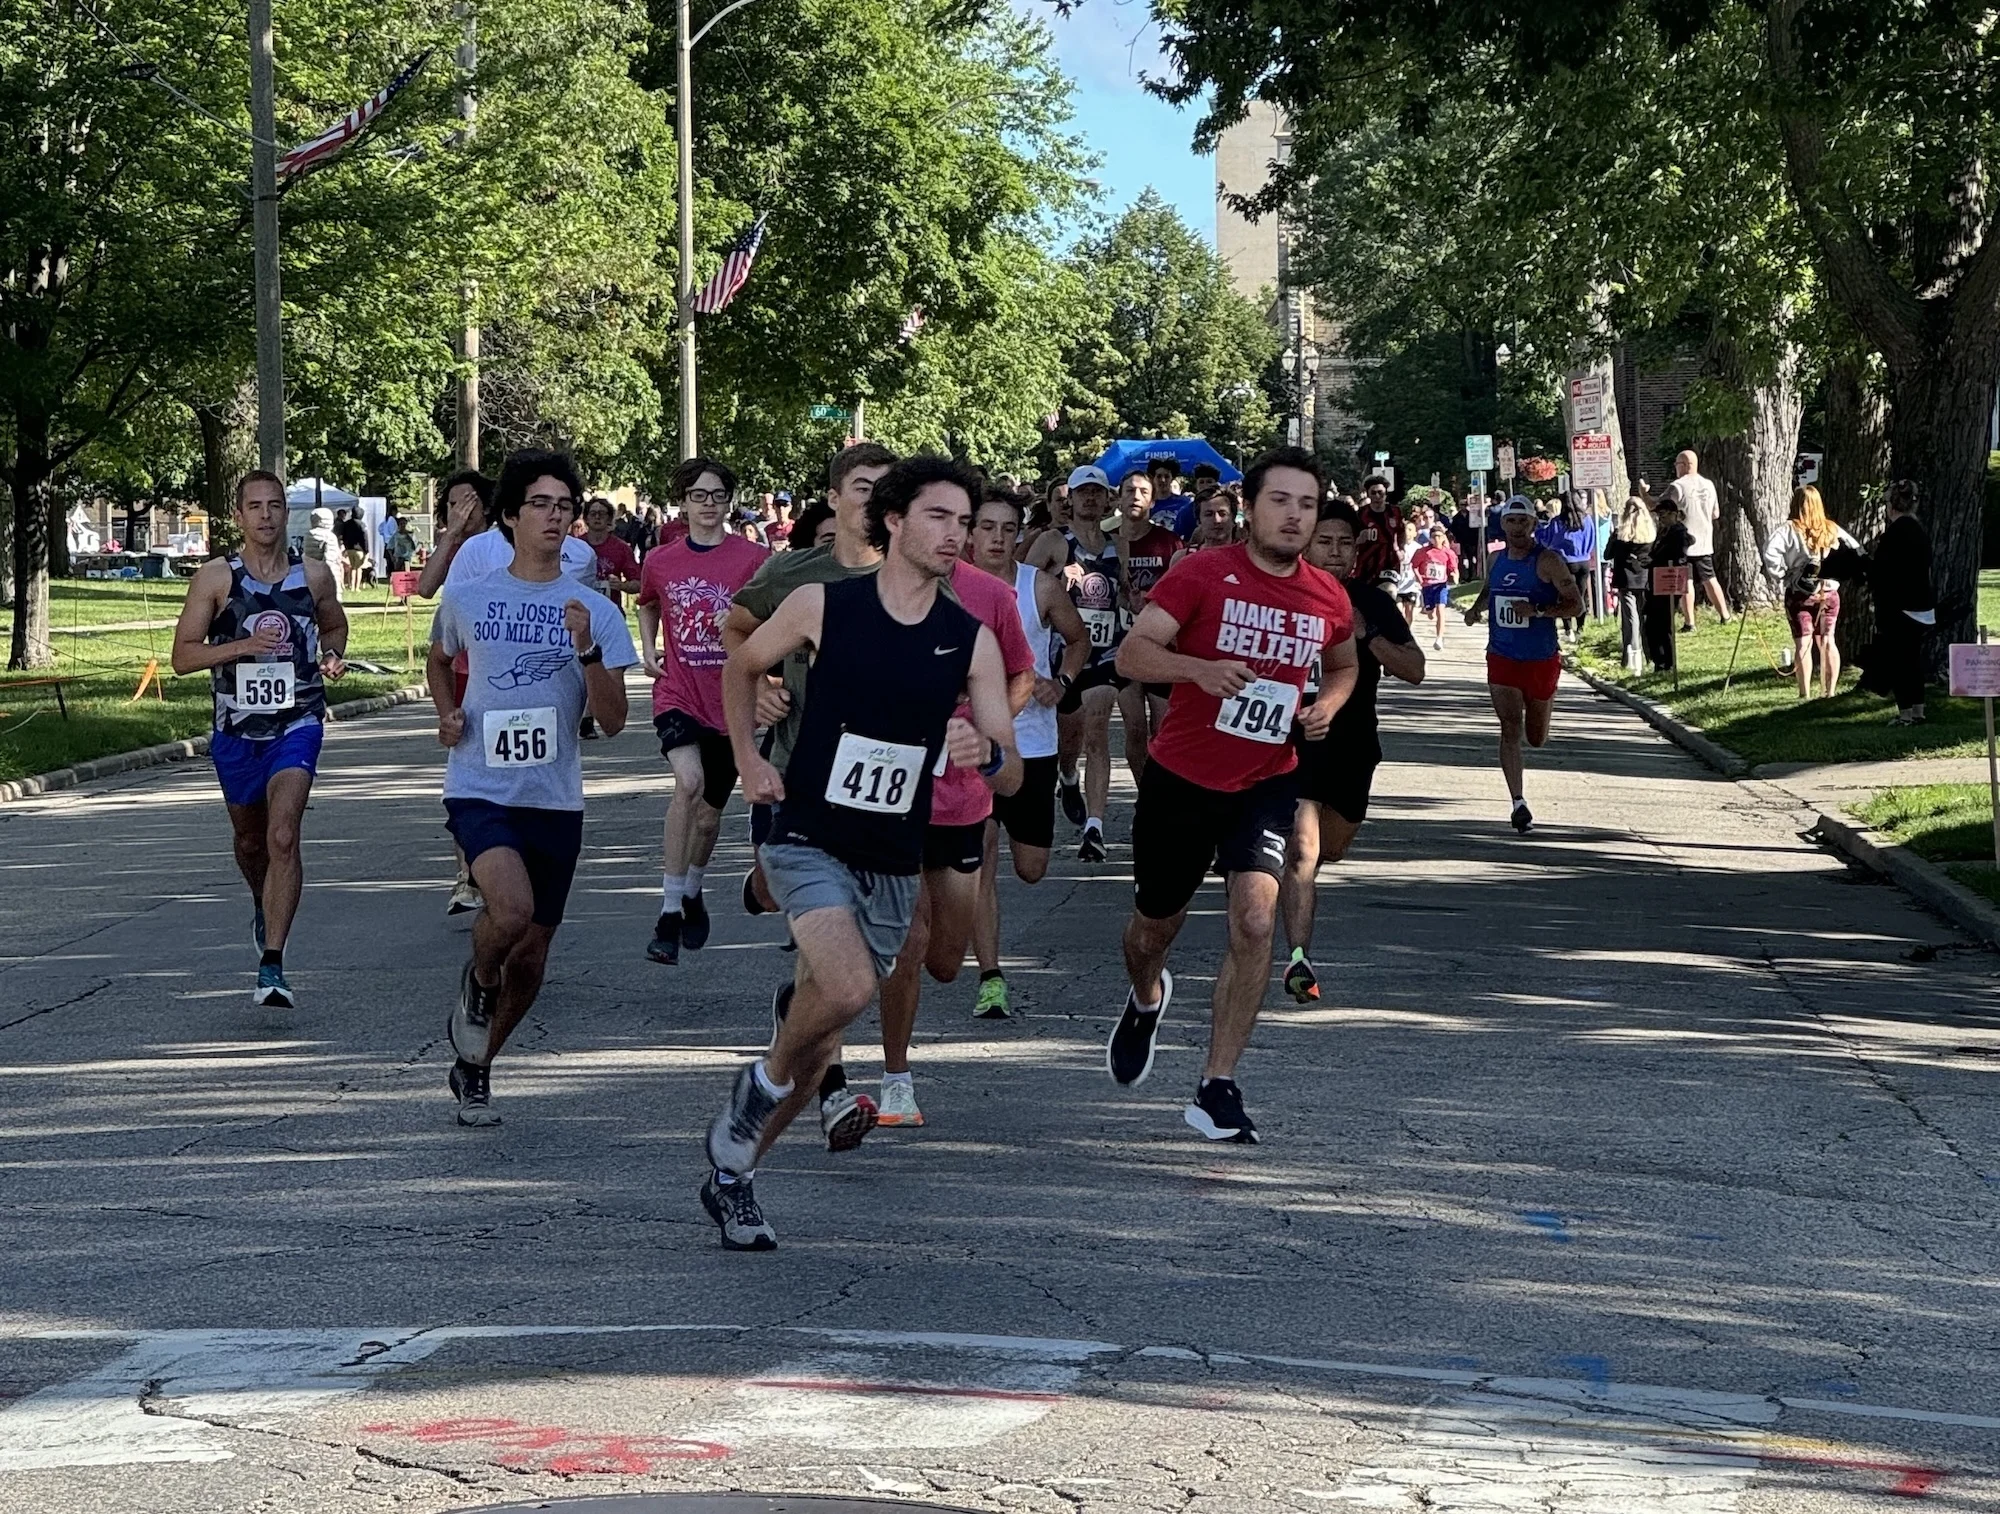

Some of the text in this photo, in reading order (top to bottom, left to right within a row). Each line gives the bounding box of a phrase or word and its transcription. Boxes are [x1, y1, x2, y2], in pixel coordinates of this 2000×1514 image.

[1145, 451, 1176, 459] FINISH
[487, 601, 568, 626] ST. JOSEP
[1222, 598, 1326, 642] MAKE 'EM
[474, 621, 500, 642] 300
[504, 622, 544, 644] MILE
[245, 678, 286, 706] 539
[1229, 695, 1285, 738] 794
[495, 727, 547, 762] 456
[842, 761, 907, 806] 418
